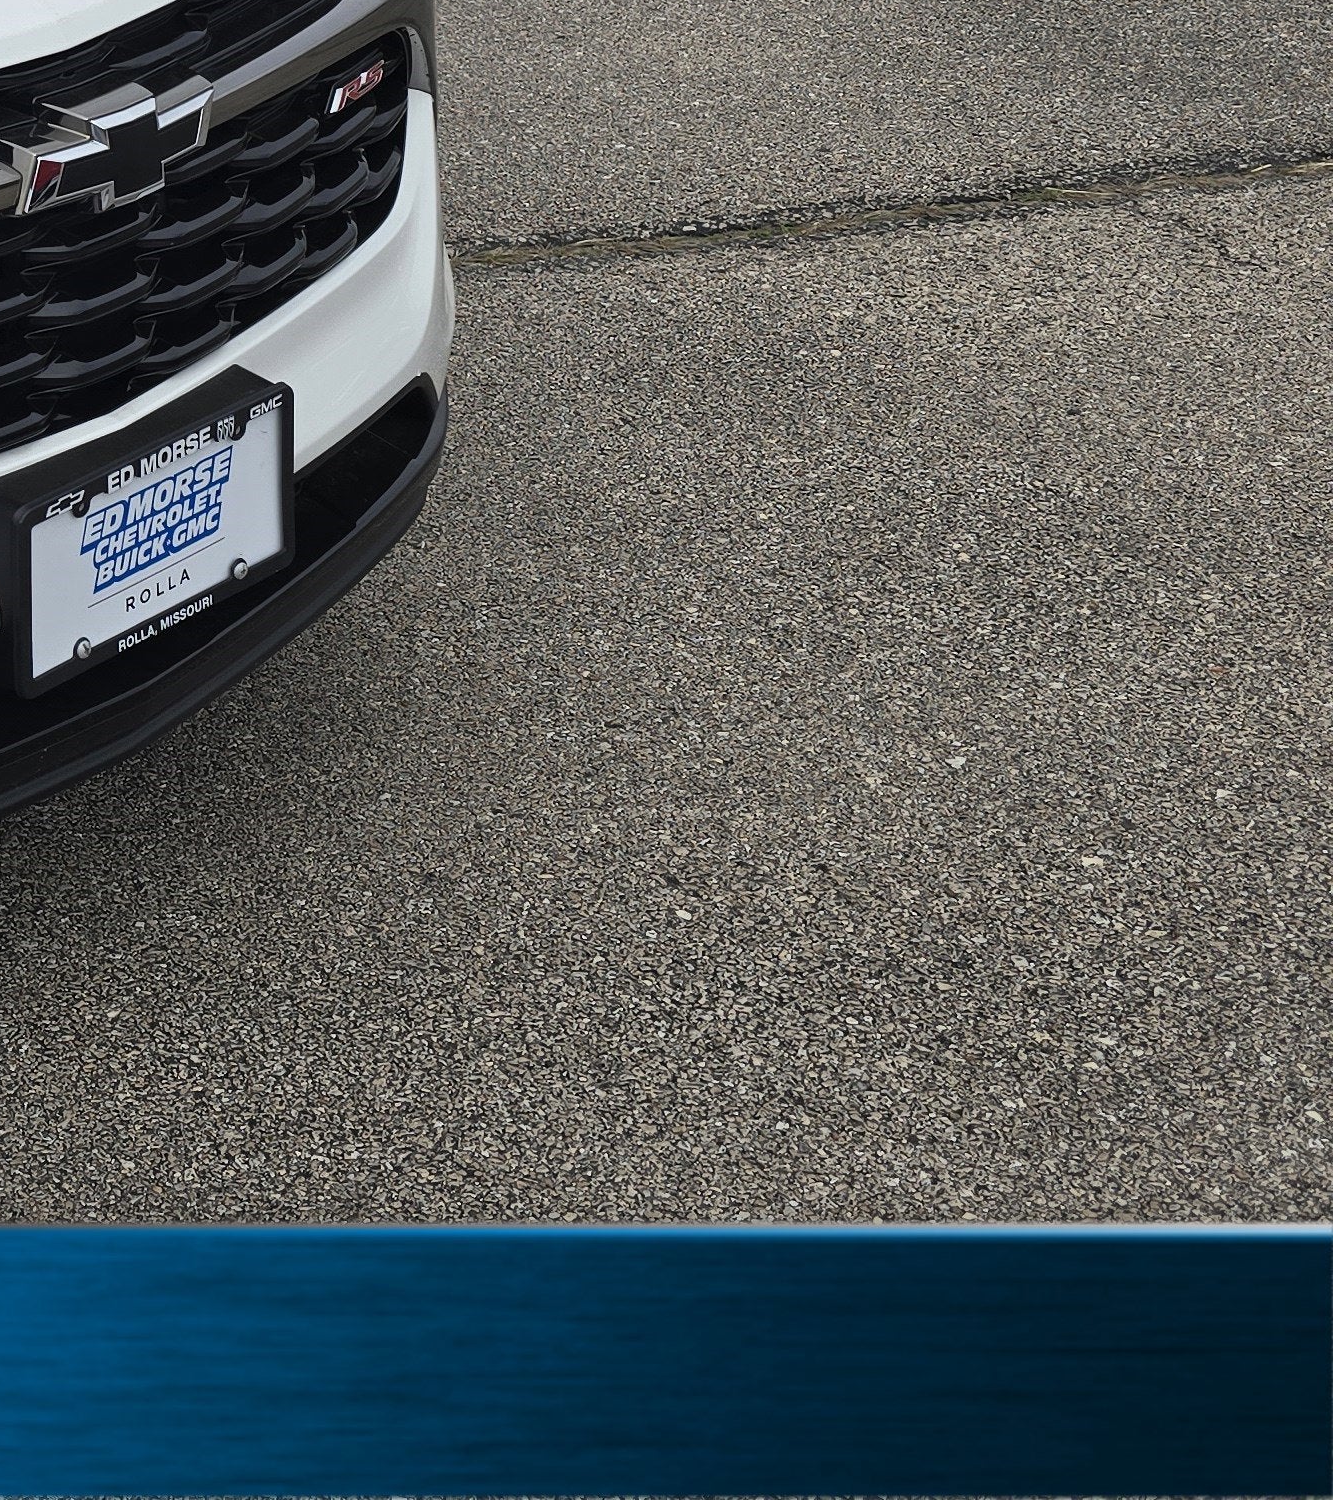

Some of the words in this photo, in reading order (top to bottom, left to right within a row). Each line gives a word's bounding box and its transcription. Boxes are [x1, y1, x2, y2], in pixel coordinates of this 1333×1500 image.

[249, 393, 283, 420] GMC
[107, 464, 134, 494] ED
[139, 425, 212, 478] MORSE
[83, 502, 125, 547] ED
[126, 448, 232, 526] MORSE
[125, 568, 191, 613] ROLLA
[118, 624, 158, 653] ROLLA,
[160, 594, 214, 631] MISSOURI
